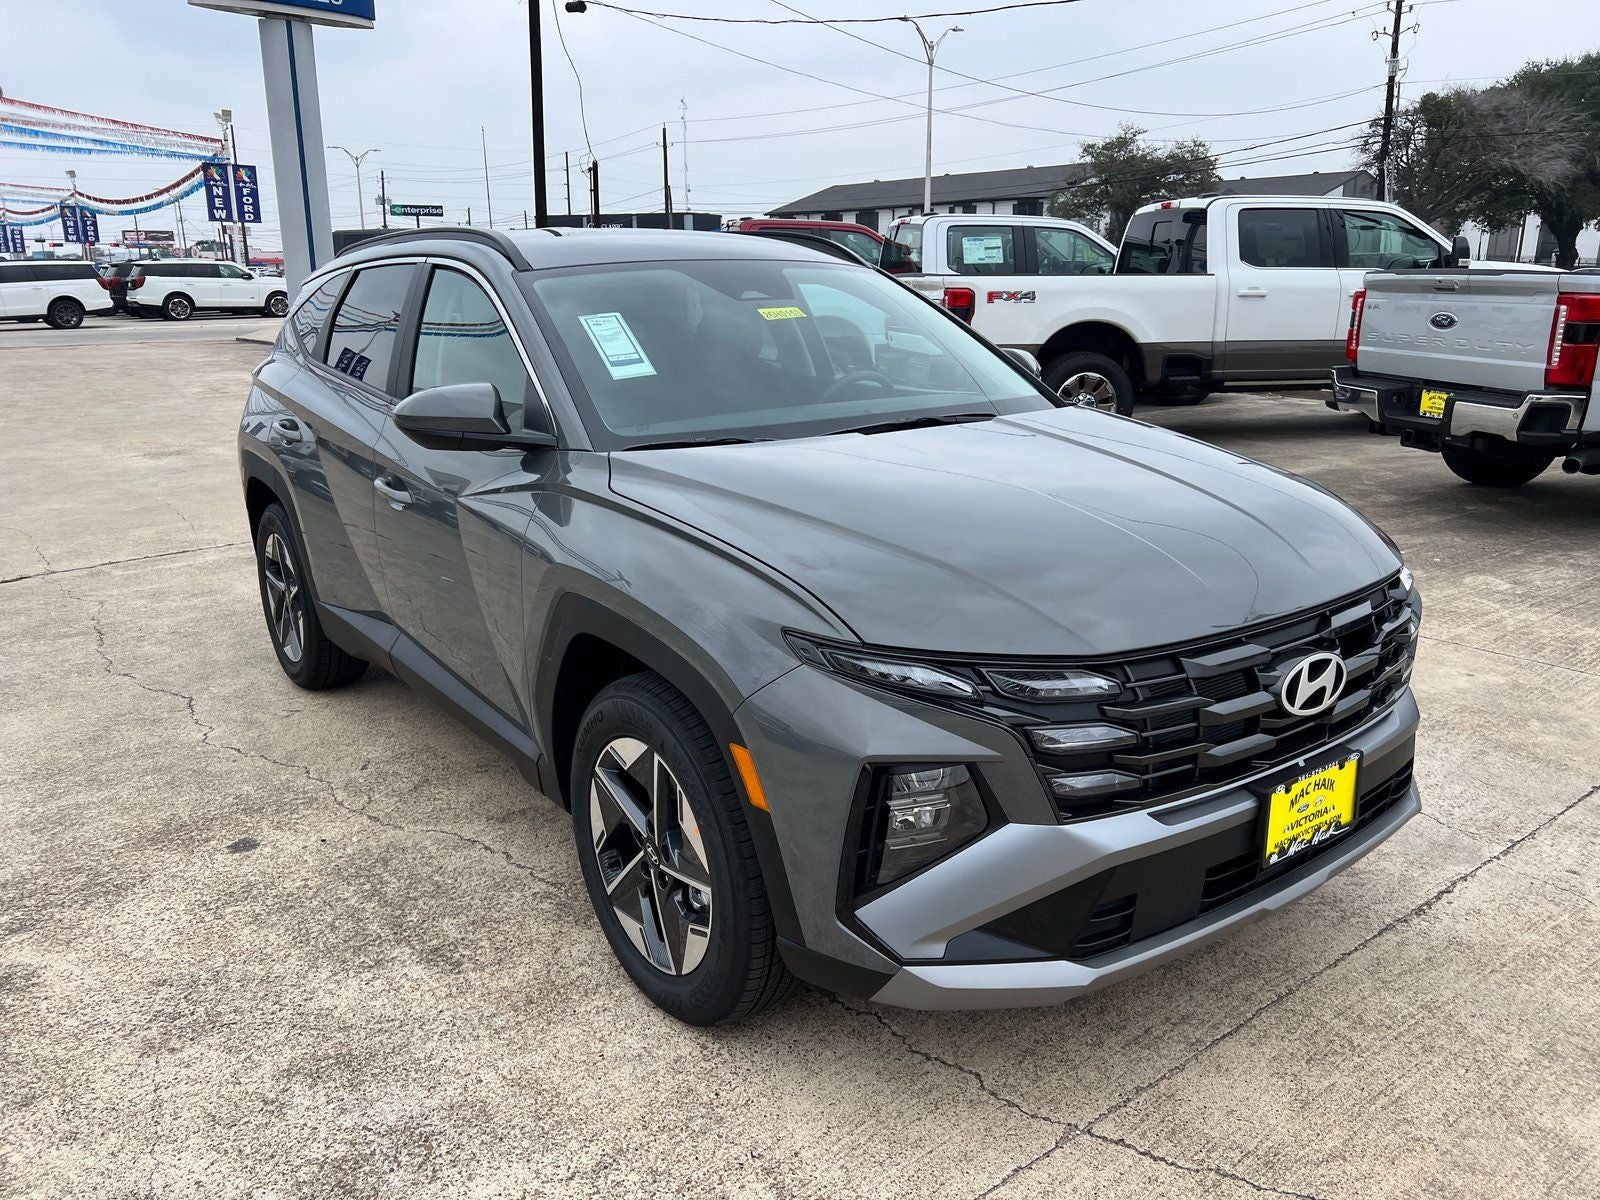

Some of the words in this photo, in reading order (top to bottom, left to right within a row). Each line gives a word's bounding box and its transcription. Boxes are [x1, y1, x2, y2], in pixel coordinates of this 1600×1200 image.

[212, 186, 226, 219] NEW
[242, 187, 254, 220] FORD
[391, 206, 443, 215] enterprise
[66, 220, 76, 241] NEW
[86, 220, 95, 241] FORD
[986, 290, 1036, 303] FX4
[1367, 331, 1447, 347] SUPER
[1455, 338, 1535, 354] DUTY
[1289, 782, 1312, 812] MAC
[1313, 777, 1336, 792] HAIK
[1290, 805, 1329, 831] VICTORIA
[1287, 839, 1311, 857] Mac
[1311, 821, 1341, 846] Haik
